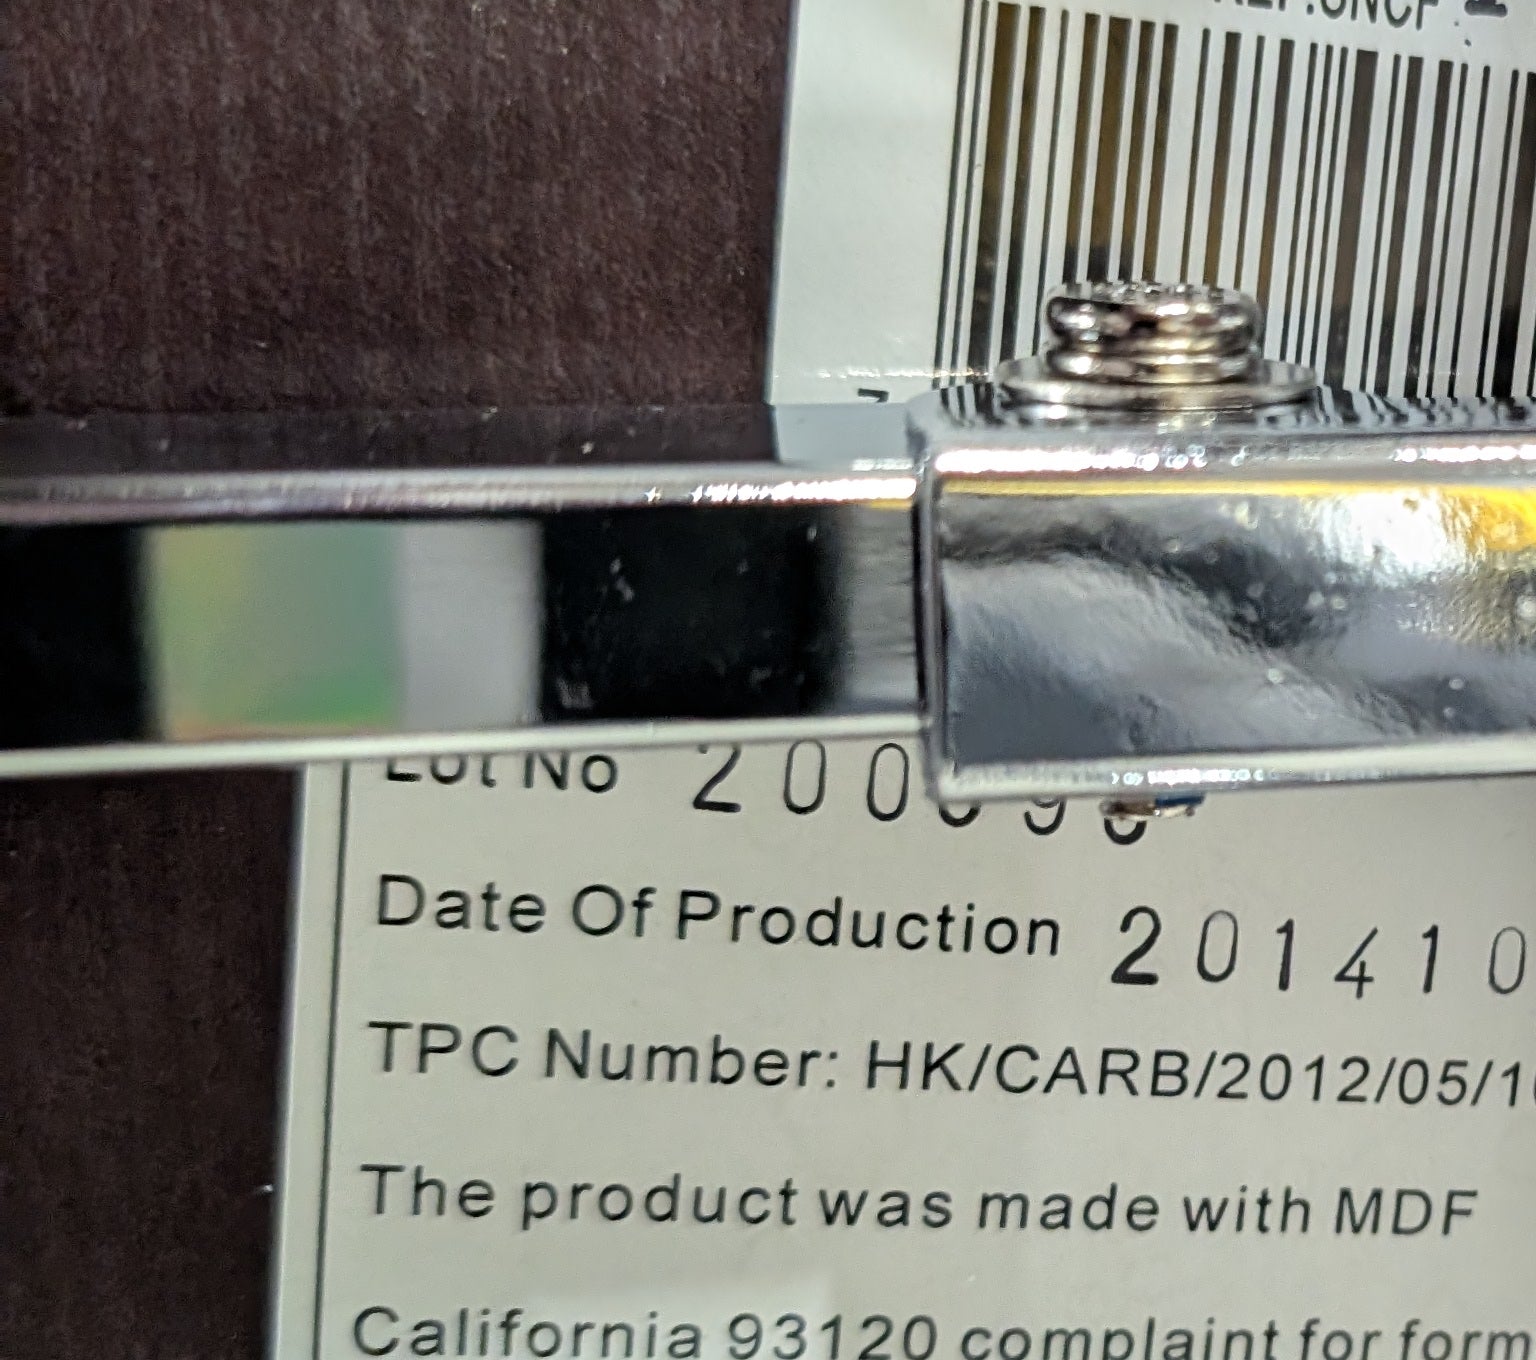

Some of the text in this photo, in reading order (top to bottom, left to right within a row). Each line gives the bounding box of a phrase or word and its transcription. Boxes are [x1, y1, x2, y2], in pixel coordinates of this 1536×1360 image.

[522, 749, 618, 794] No
[377, 874, 547, 933] Date
[570, 884, 657, 937] Of
[675, 889, 1061, 957] Production
[367, 1021, 519, 1078] TPC
[544, 1028, 838, 1089] Number:
[360, 1164, 1479, 1237] The product was made with MDF
[352, 1306, 702, 1359] California
